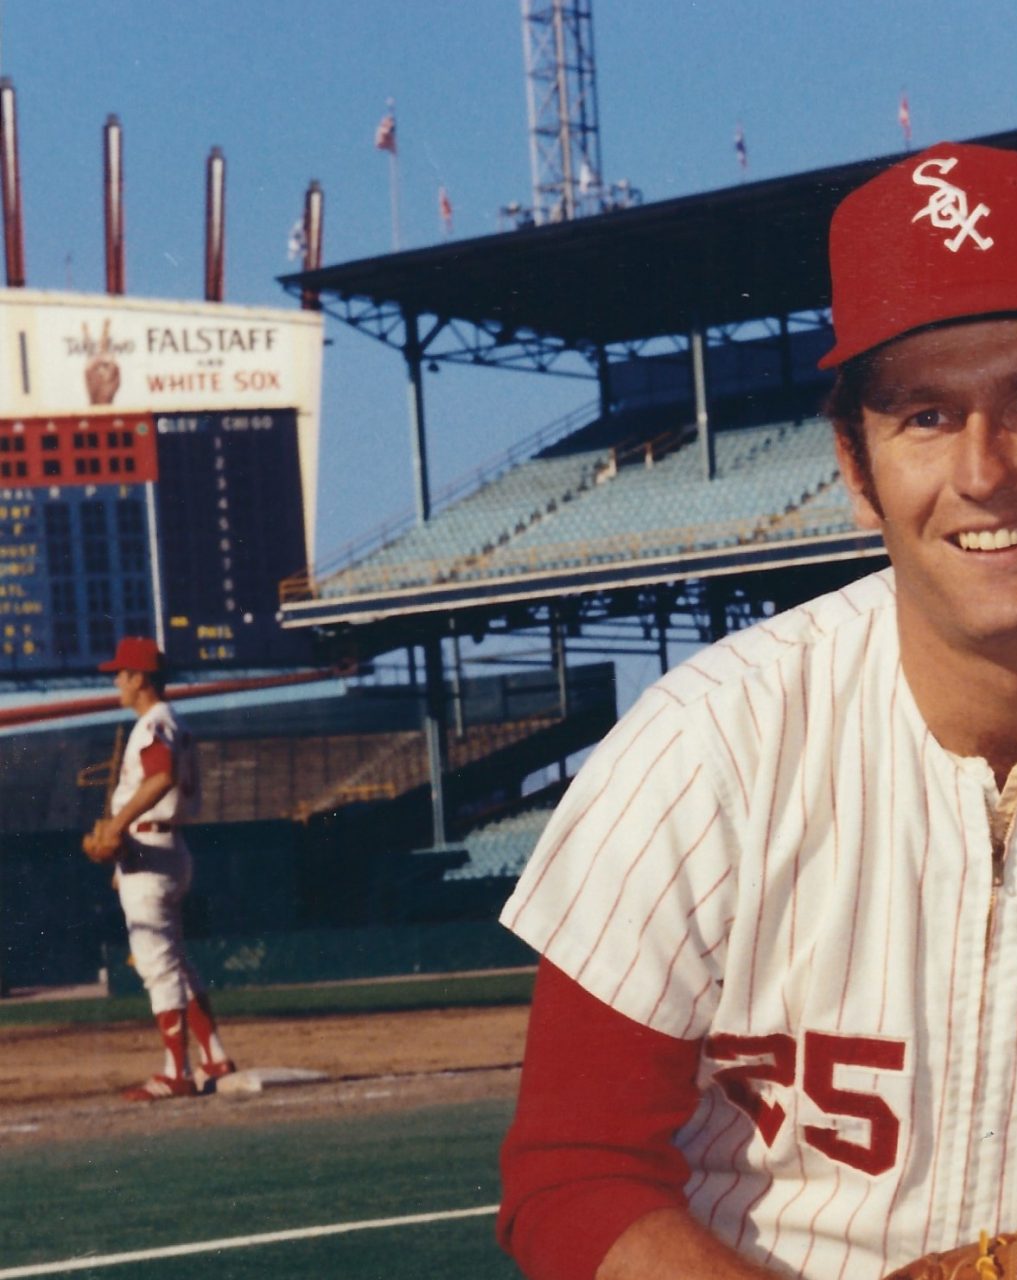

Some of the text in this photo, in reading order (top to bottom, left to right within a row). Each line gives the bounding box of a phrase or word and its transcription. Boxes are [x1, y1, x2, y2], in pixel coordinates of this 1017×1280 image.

[147, 328, 279, 353] FALSTAFF
[147, 370, 282, 394] WHITE SOX
